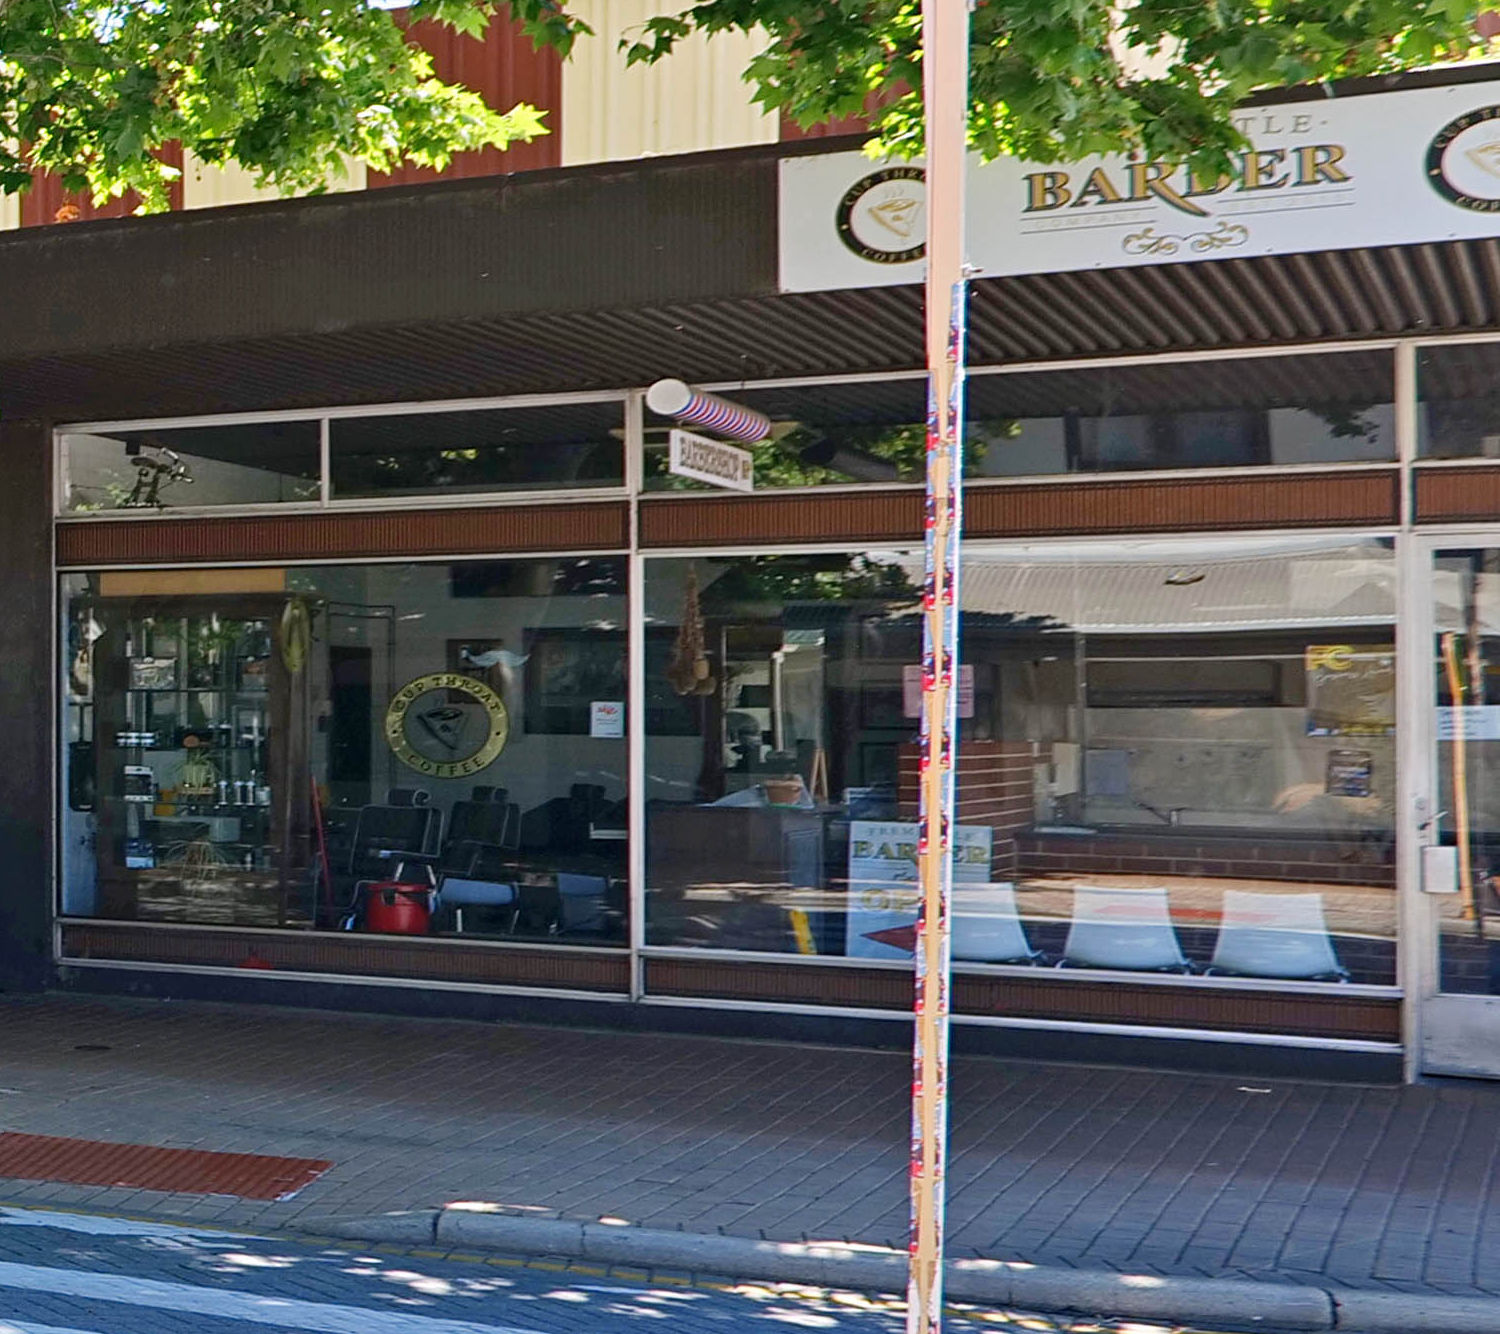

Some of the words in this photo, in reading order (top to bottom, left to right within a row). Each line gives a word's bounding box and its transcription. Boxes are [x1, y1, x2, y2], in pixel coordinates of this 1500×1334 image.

[861, 248, 923, 262] COFFE
[392, 683, 425, 712] CUP
[432, 676, 500, 711] THROAT
[408, 757, 485, 776] COFFEE
[852, 841, 989, 866] BARER
